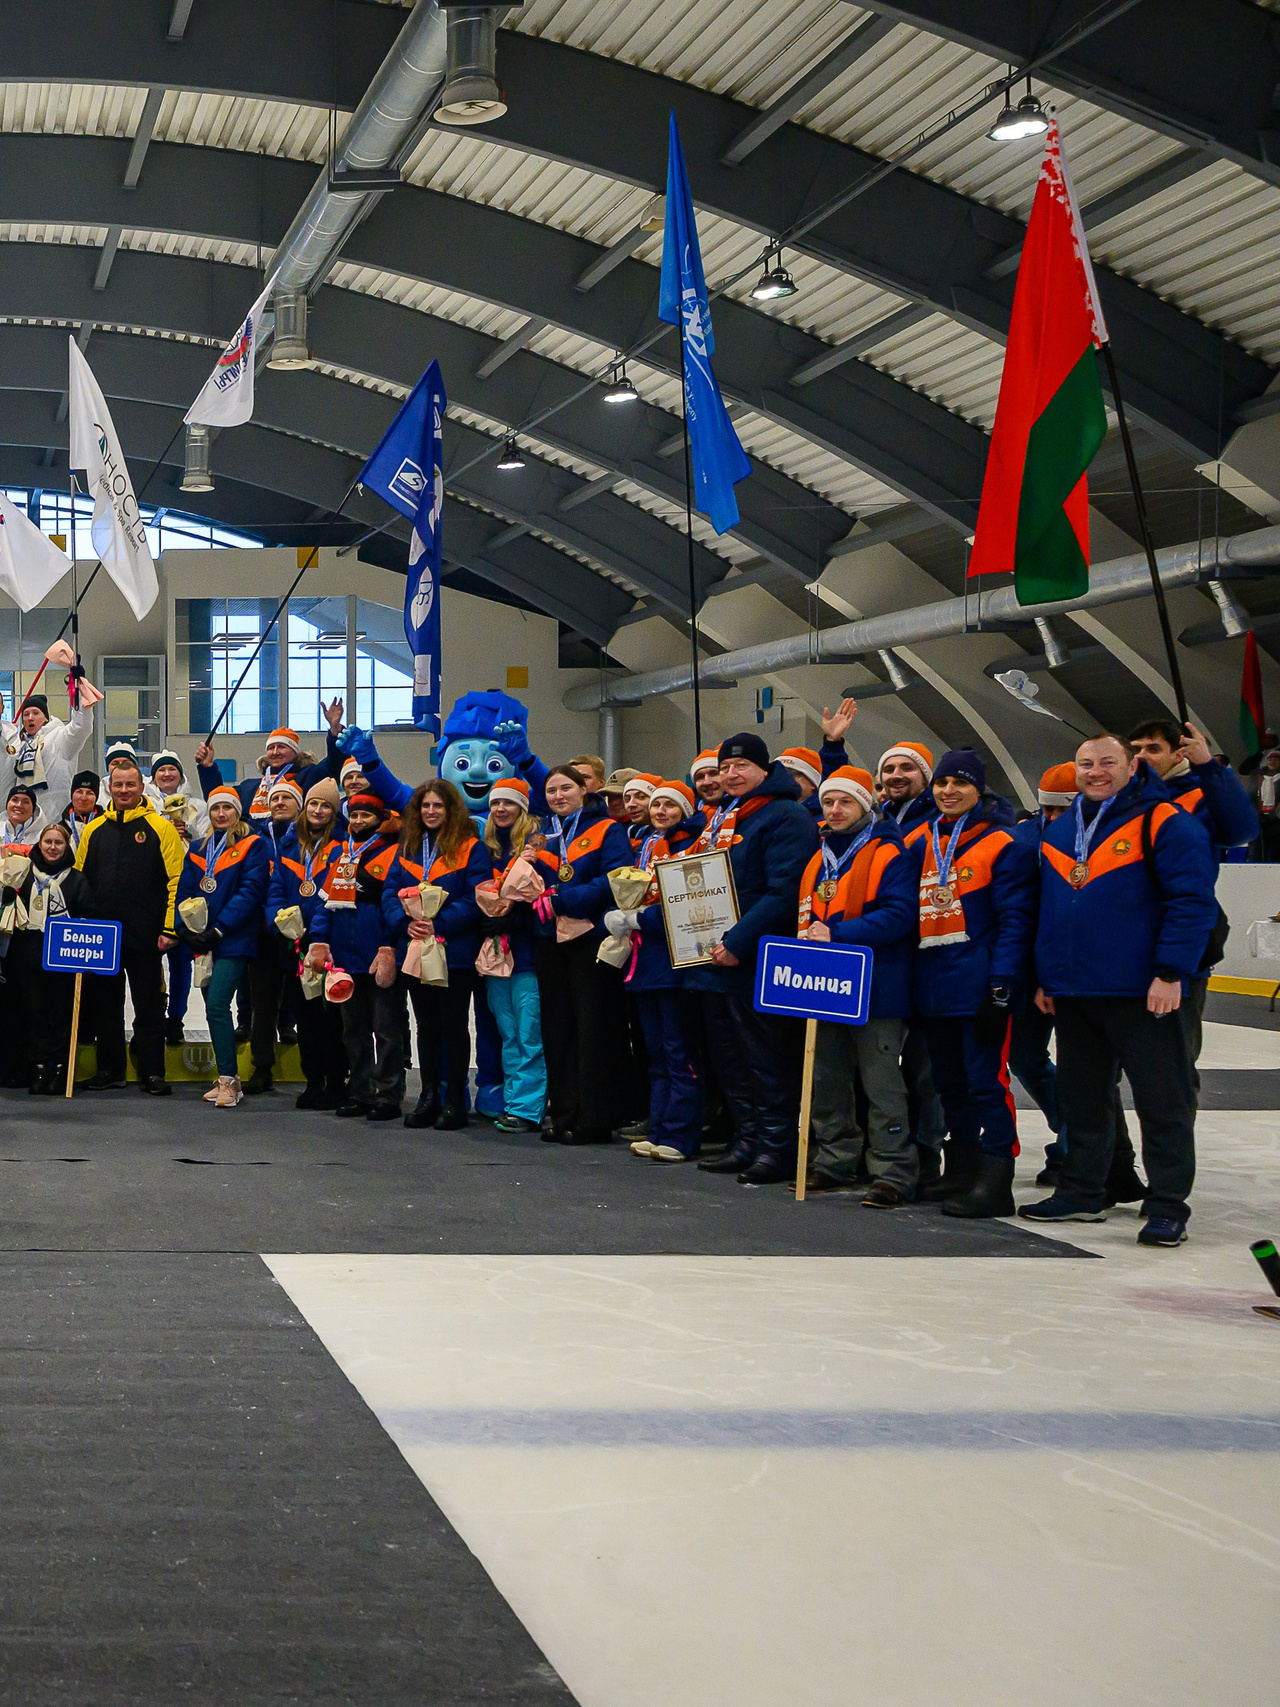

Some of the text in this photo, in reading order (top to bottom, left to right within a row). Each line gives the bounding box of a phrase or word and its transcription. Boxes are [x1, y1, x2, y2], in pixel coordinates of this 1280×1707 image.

[668, 886, 728, 904] СЕРТИФИКАТ
[63, 928, 104, 944] Белые
[60, 947, 104, 962] тигры
[773, 965, 853, 996] Молния
